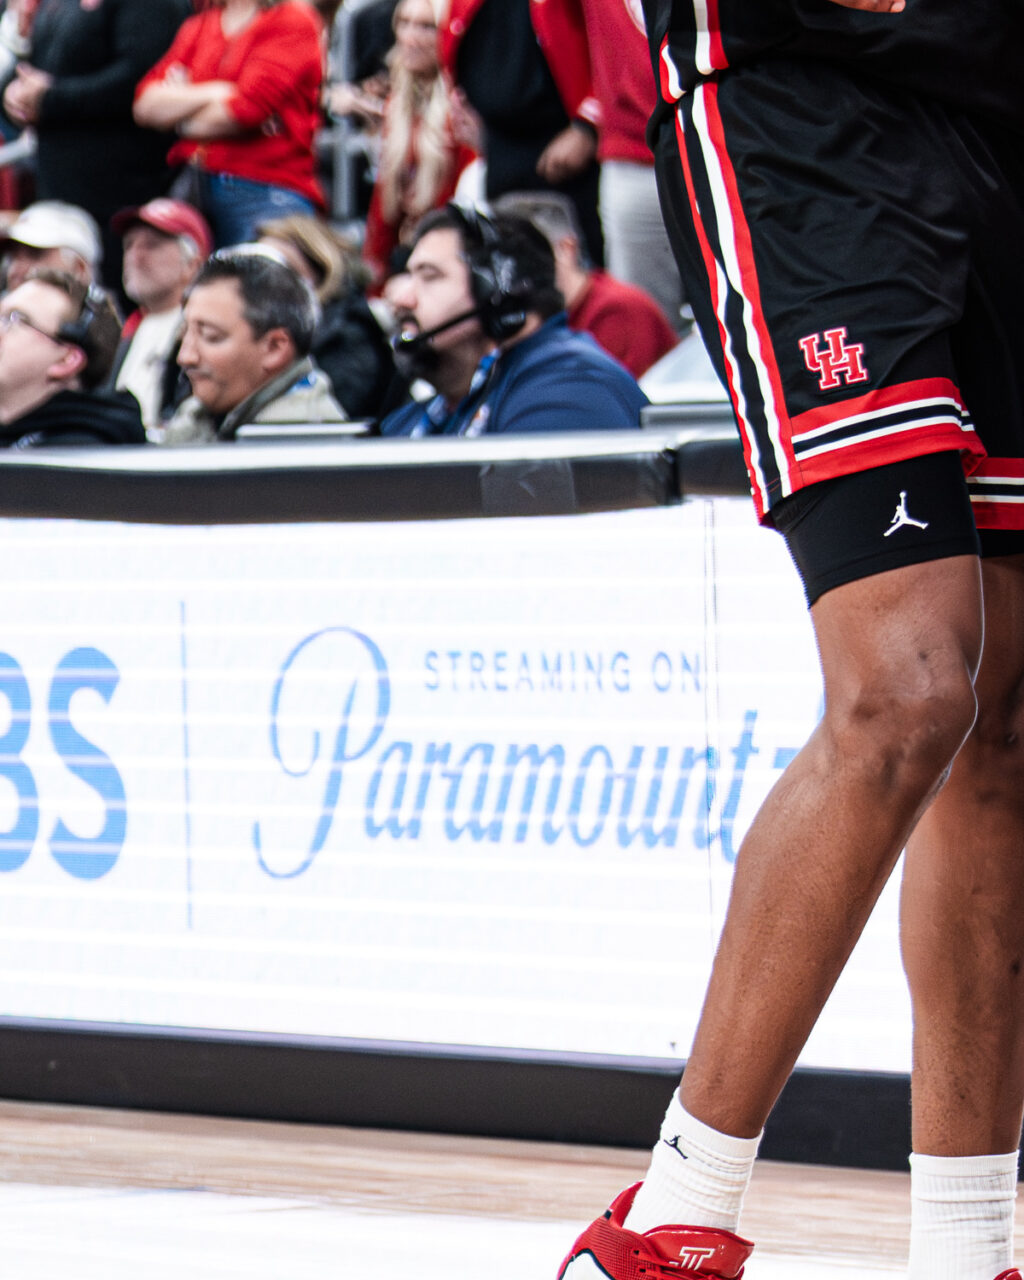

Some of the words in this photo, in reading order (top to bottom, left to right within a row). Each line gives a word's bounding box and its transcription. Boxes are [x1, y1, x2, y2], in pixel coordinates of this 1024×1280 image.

[424, 650, 631, 693] STREAMING
[652, 650, 702, 693] ON
[252, 625, 827, 880] Paramount
